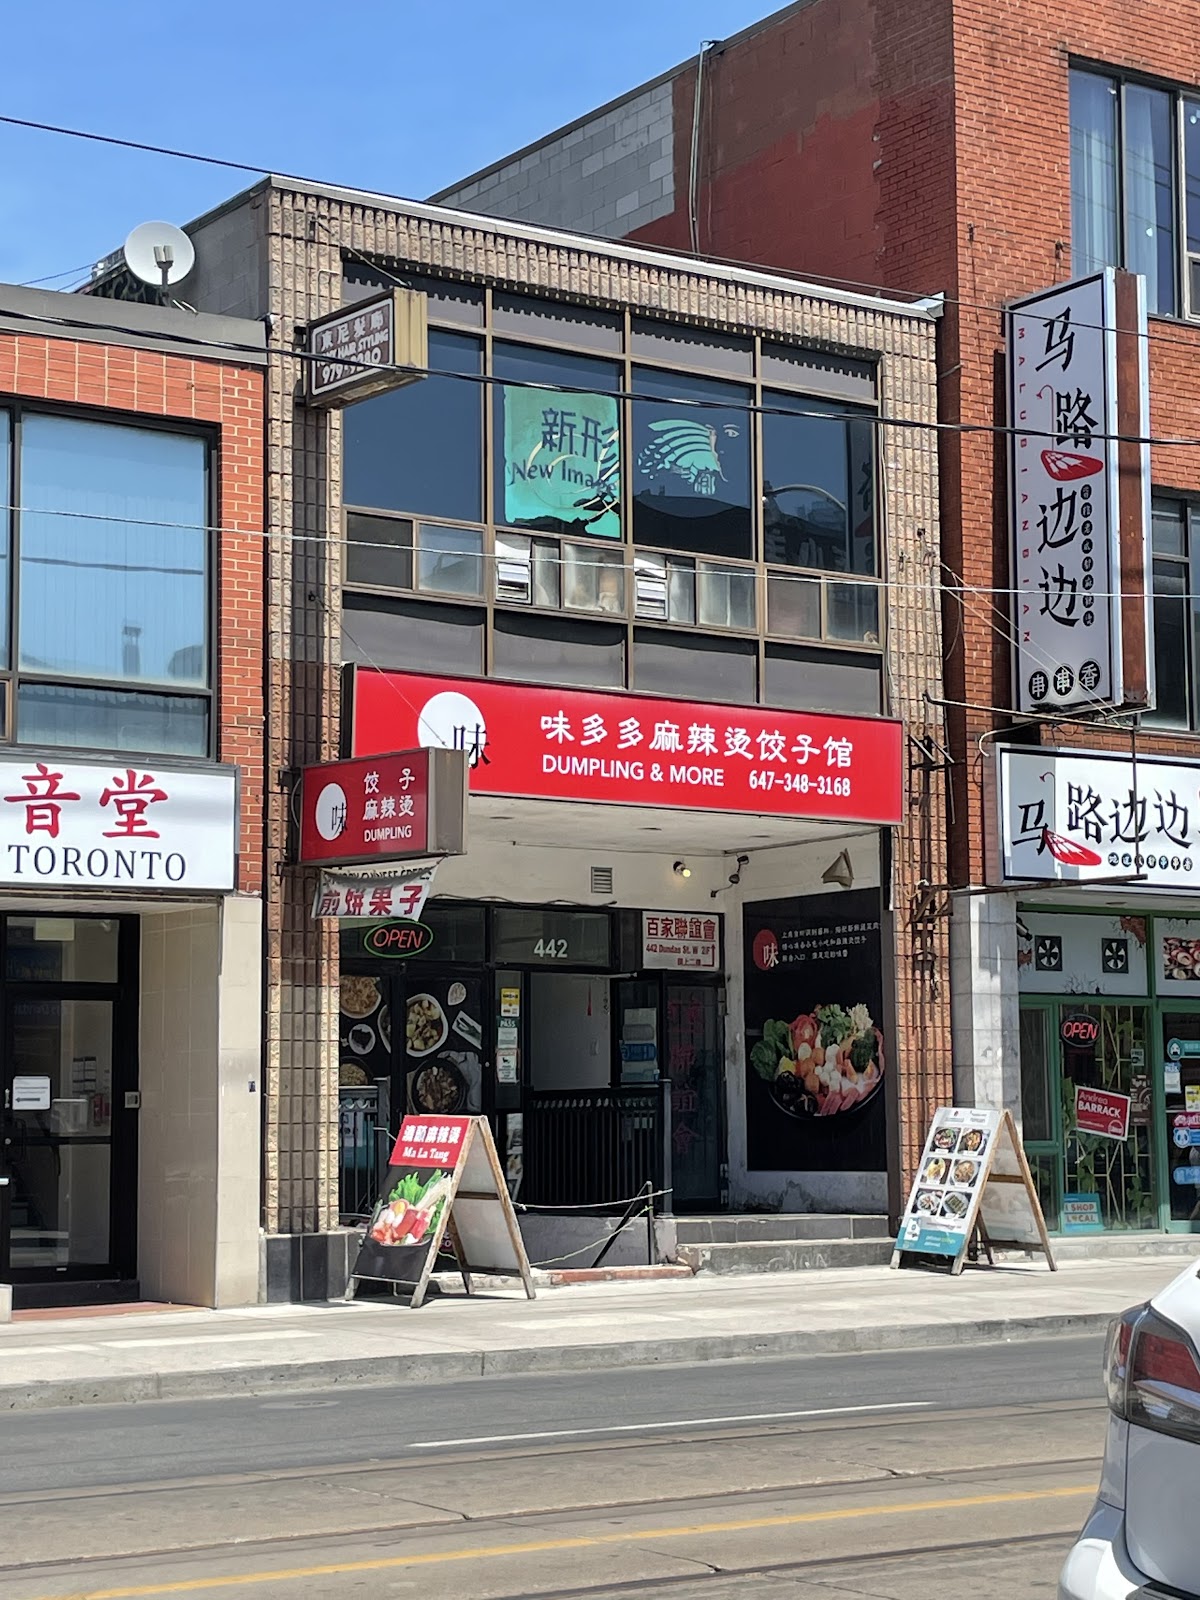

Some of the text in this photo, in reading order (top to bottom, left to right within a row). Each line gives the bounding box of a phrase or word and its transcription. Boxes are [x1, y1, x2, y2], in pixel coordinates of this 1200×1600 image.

[508, 460, 554, 486] New
[540, 709, 853, 768] 味多多麻辣烫饺子馆
[543, 754, 724, 787] DUMPLING & MORE
[749, 769, 850, 797] 647-348-3168
[3, 762, 168, 839] 音堂
[362, 795, 415, 821] 麻辣烫
[364, 825, 412, 842] DUMPLING
[7, 845, 186, 881] TORONTO
[373, 928, 423, 949] OPEN
[646, 917, 716, 940] 百家聯誼會
[534, 939, 568, 958] 442
[646, 944, 658, 952] 442
[659, 944, 681, 953] Dundas
[1063, 1022, 1098, 1039] OPEN
[1079, 1091, 1108, 1105] Andrea
[1078, 1101, 1121, 1118] BARRACK
[402, 1147, 450, 1163] Ma La Tang
[1071, 1203, 1095, 1211] SHOP
